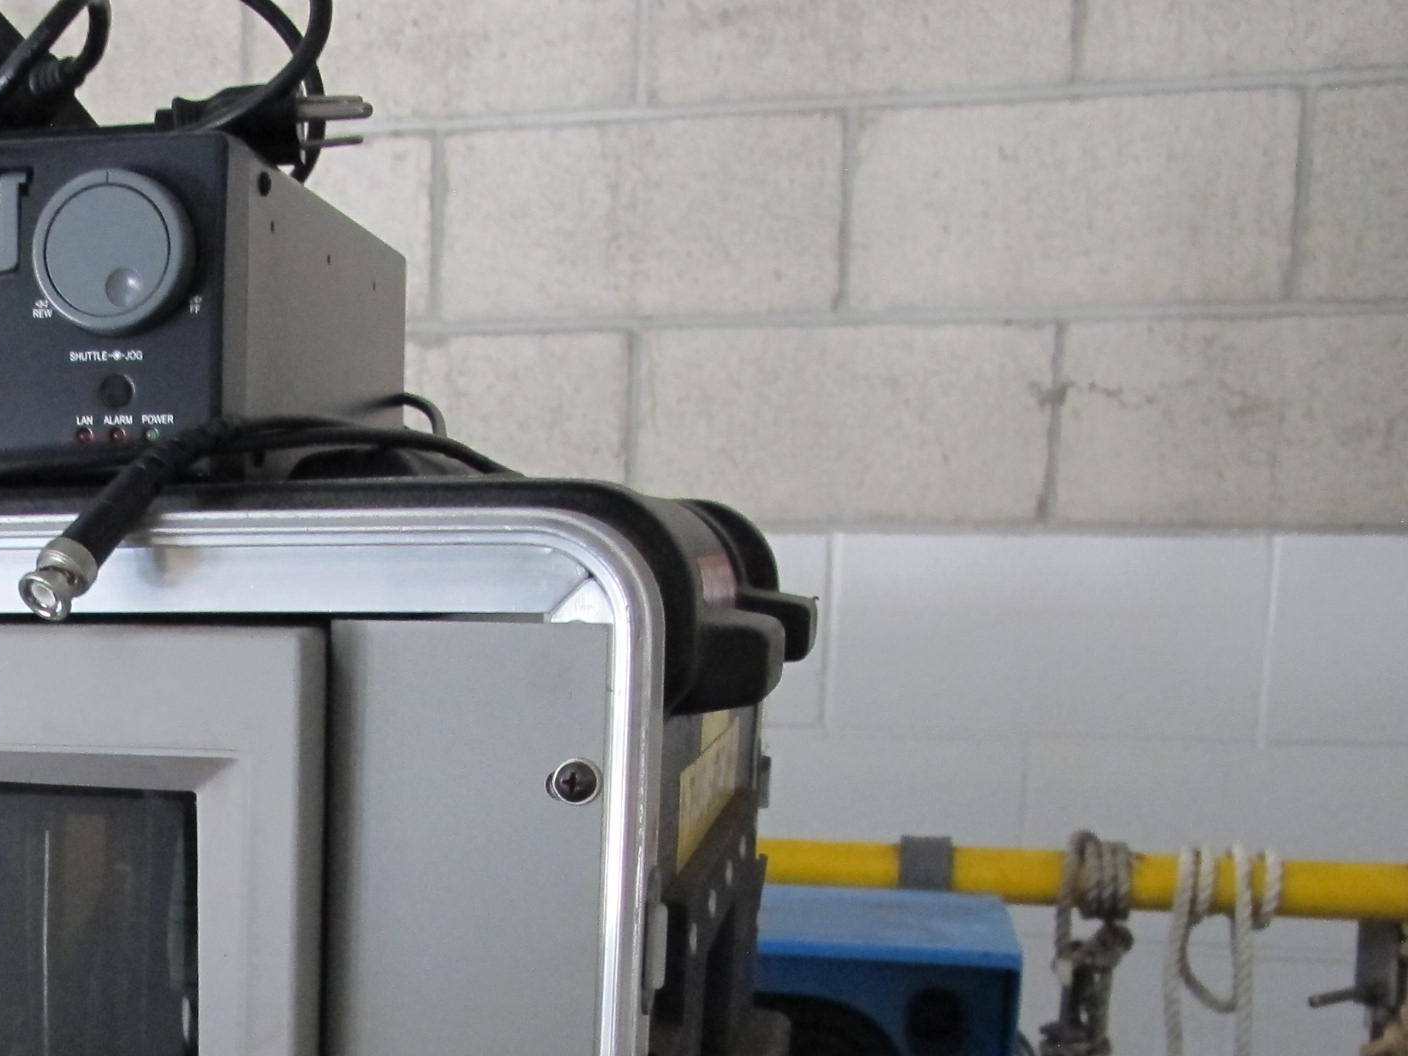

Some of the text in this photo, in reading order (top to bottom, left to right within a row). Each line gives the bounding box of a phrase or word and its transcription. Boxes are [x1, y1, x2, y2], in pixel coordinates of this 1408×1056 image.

[32, 308, 53, 319] REW
[76, 416, 93, 426] LAN
[103, 415, 133, 426] ALARM
[141, 415, 174, 426] POWER
